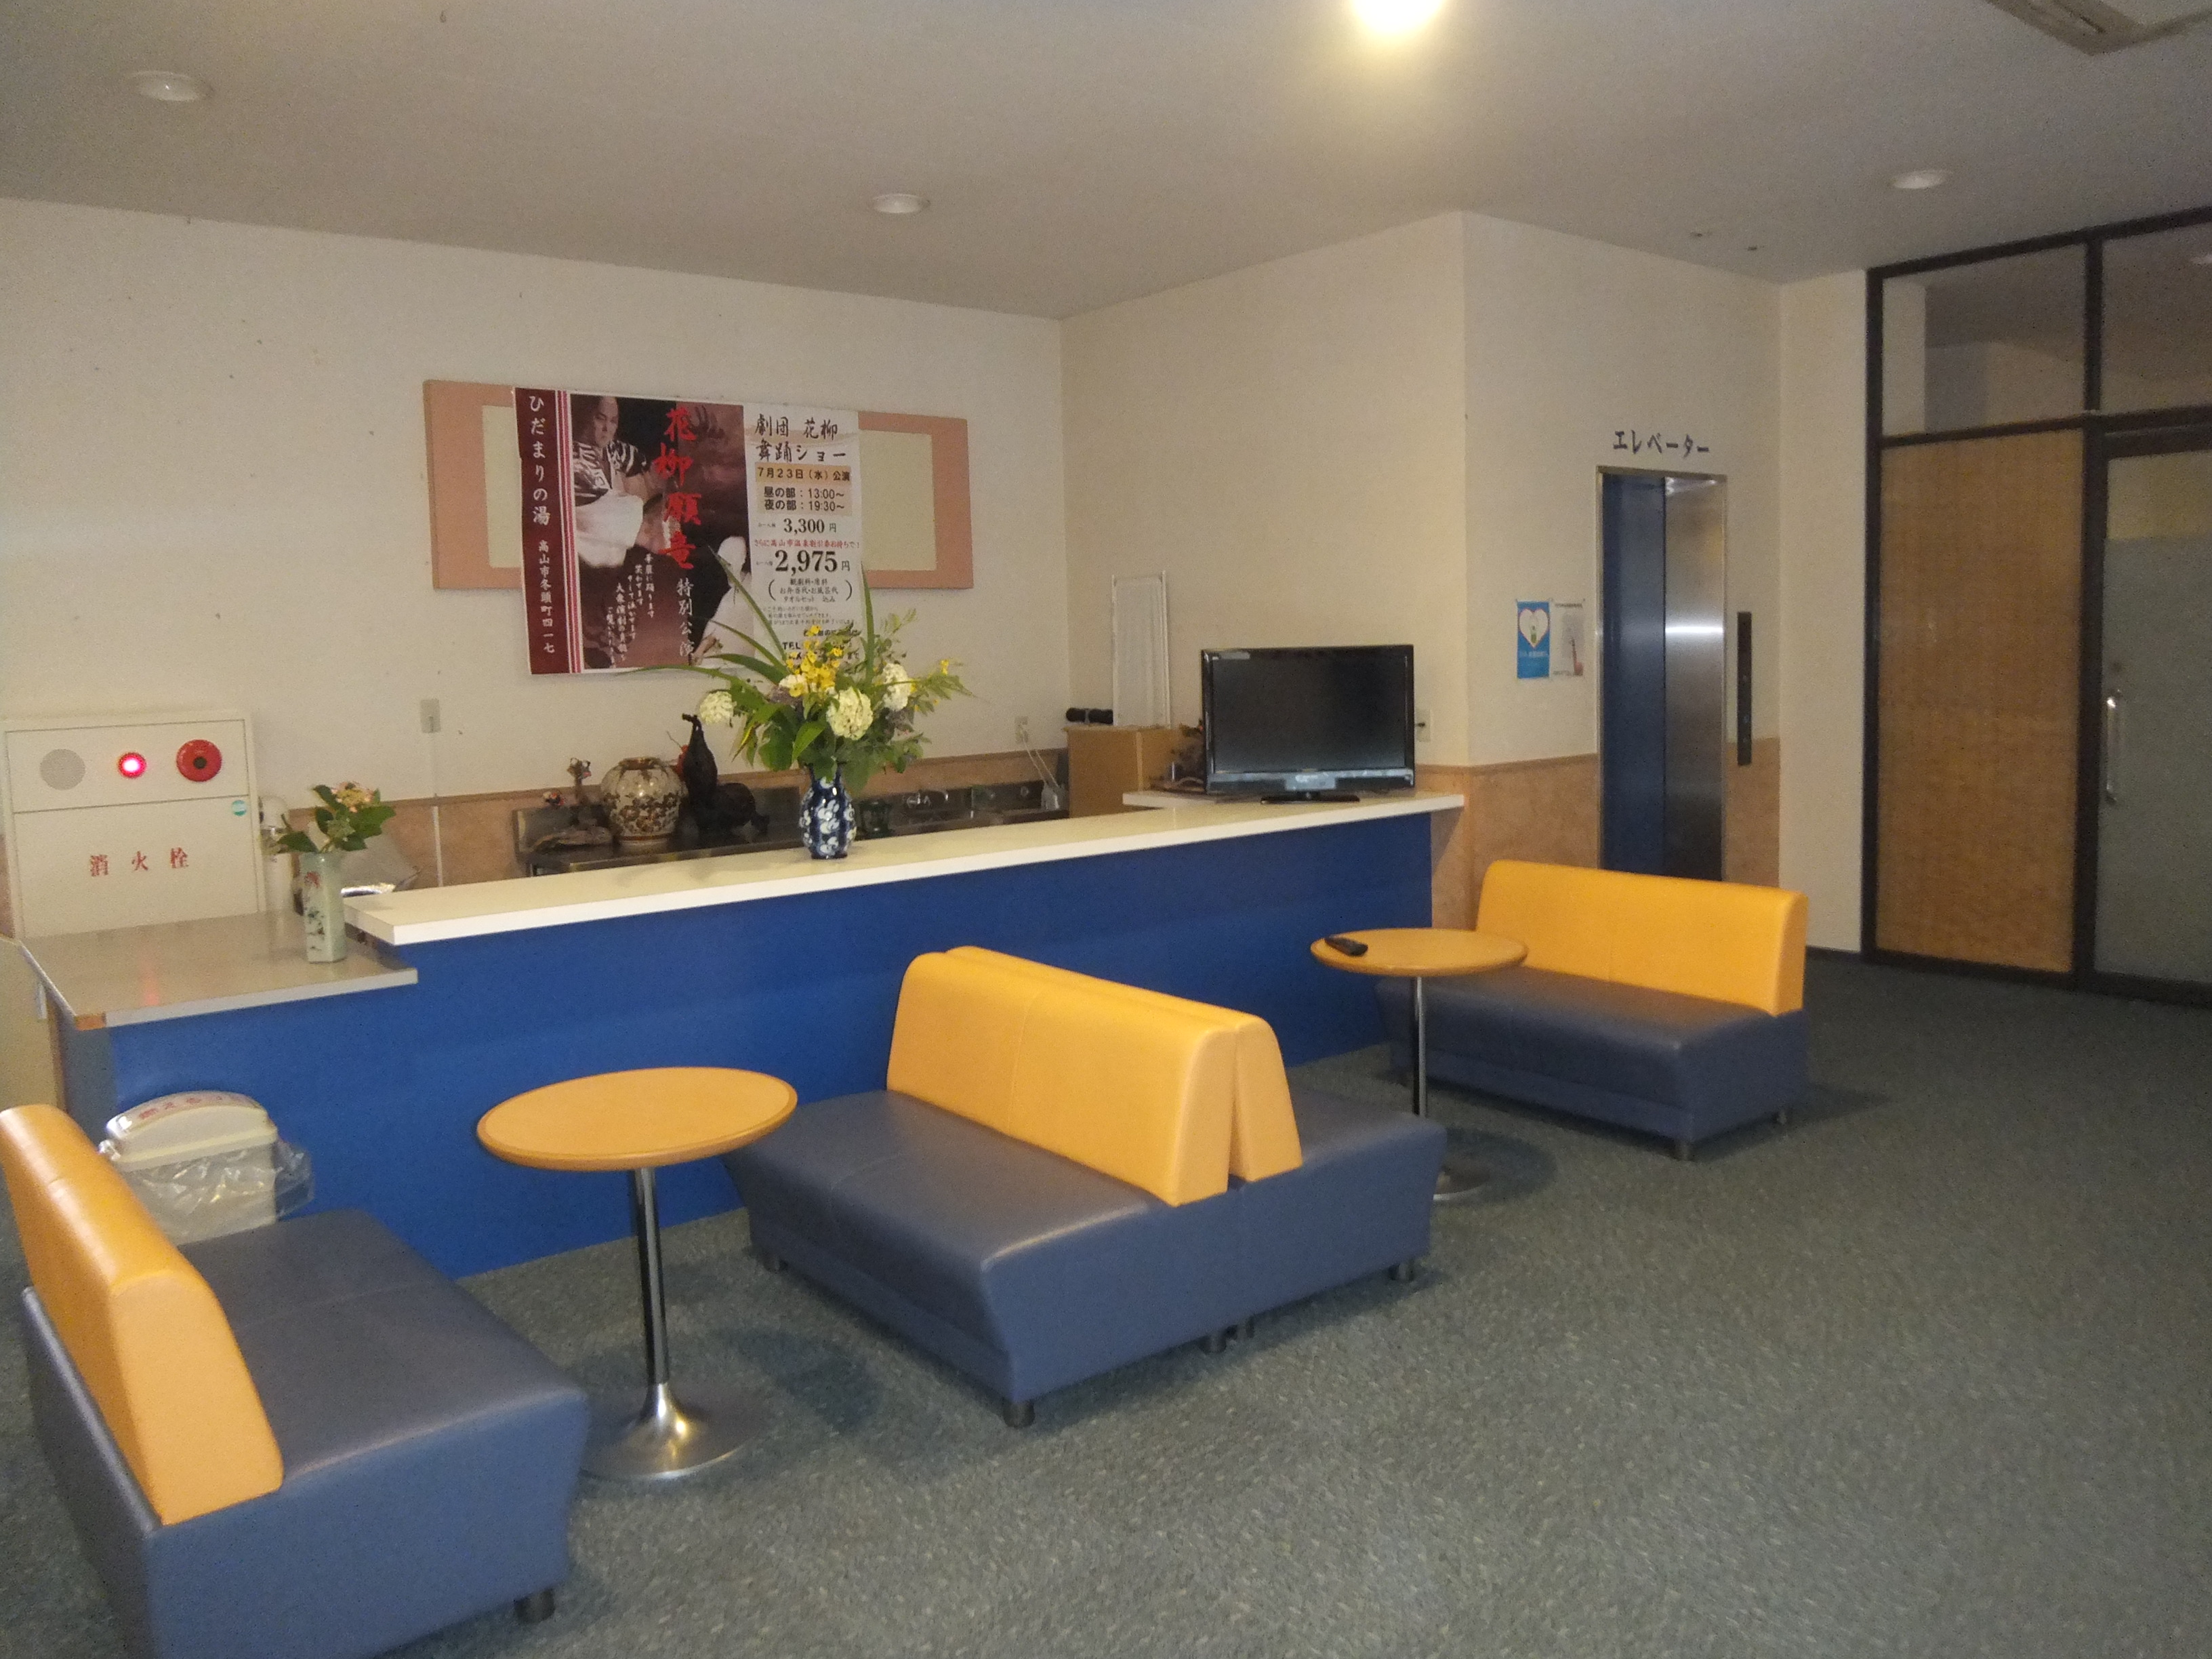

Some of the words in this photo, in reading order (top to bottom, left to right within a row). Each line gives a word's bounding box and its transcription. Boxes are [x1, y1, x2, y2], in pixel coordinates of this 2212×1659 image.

[755, 413, 788, 437] 劇団
[804, 417, 838, 441] 花柳
[756, 438, 846, 462] 舞踊ショー
[1613, 430, 1709, 458] エレベーター
[529, 396, 550, 525] ひだまりの湯
[676, 577, 695, 657] 特別公演
[783, 642, 801, 650] TEL
[89, 847, 188, 876] 消火栓
